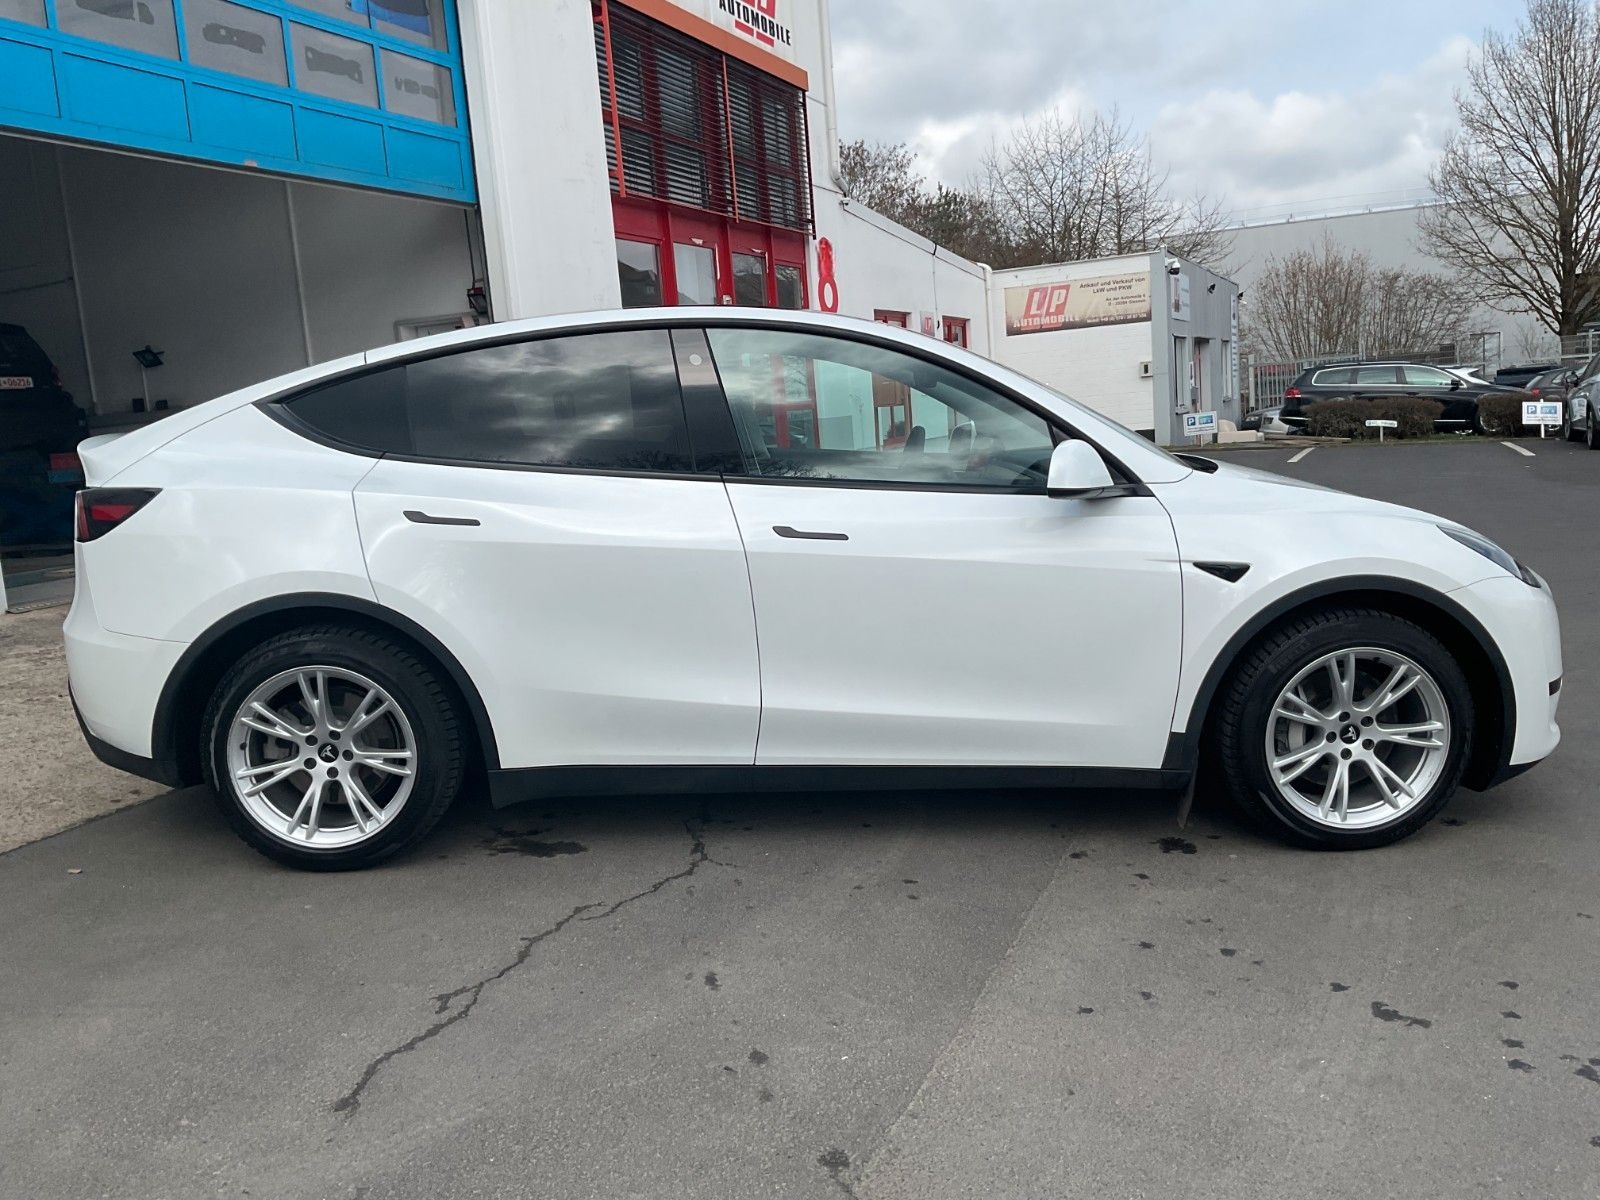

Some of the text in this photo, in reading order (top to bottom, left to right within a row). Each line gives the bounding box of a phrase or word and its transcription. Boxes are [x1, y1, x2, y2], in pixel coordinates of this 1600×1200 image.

[719, 0, 791, 46] AUTOMOBILE
[1080, 281, 1100, 289] Ankauf
[1112, 277, 1134, 286] Verkauf
